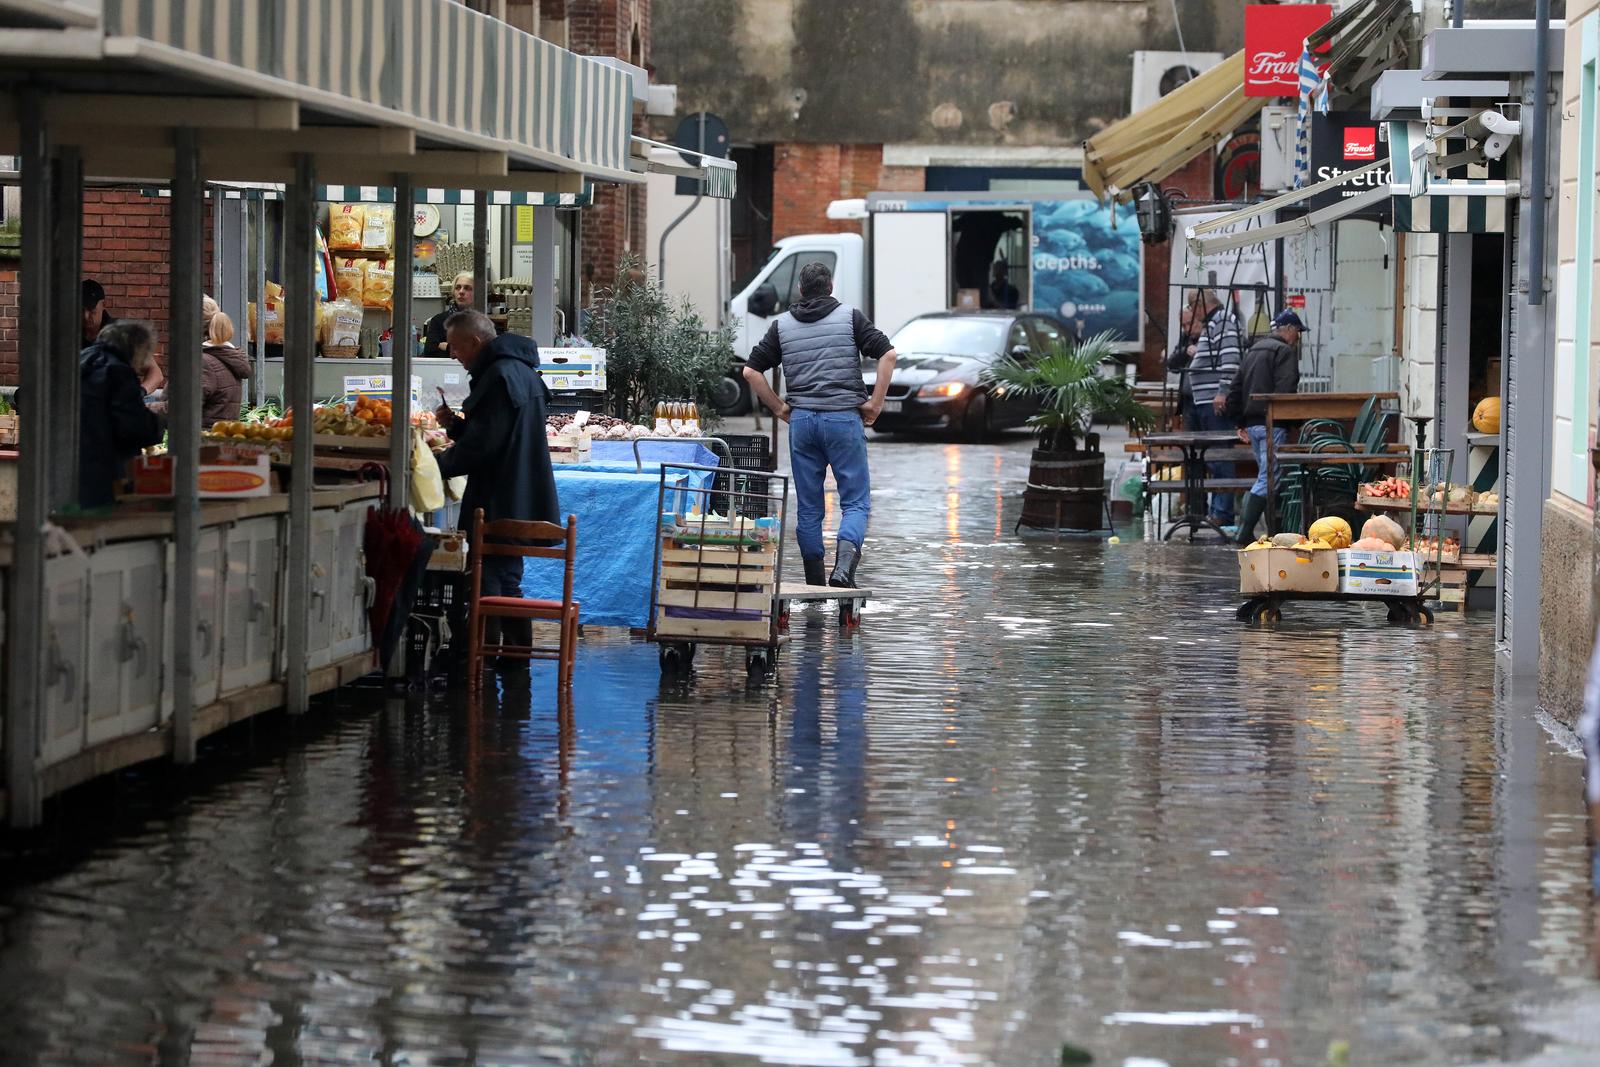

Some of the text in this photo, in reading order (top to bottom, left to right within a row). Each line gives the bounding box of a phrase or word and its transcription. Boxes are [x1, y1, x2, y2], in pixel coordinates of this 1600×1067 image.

[1249, 51, 1321, 76] Fran
[1345, 143, 1374, 153] Franck
[1034, 254, 1102, 273] depths.
